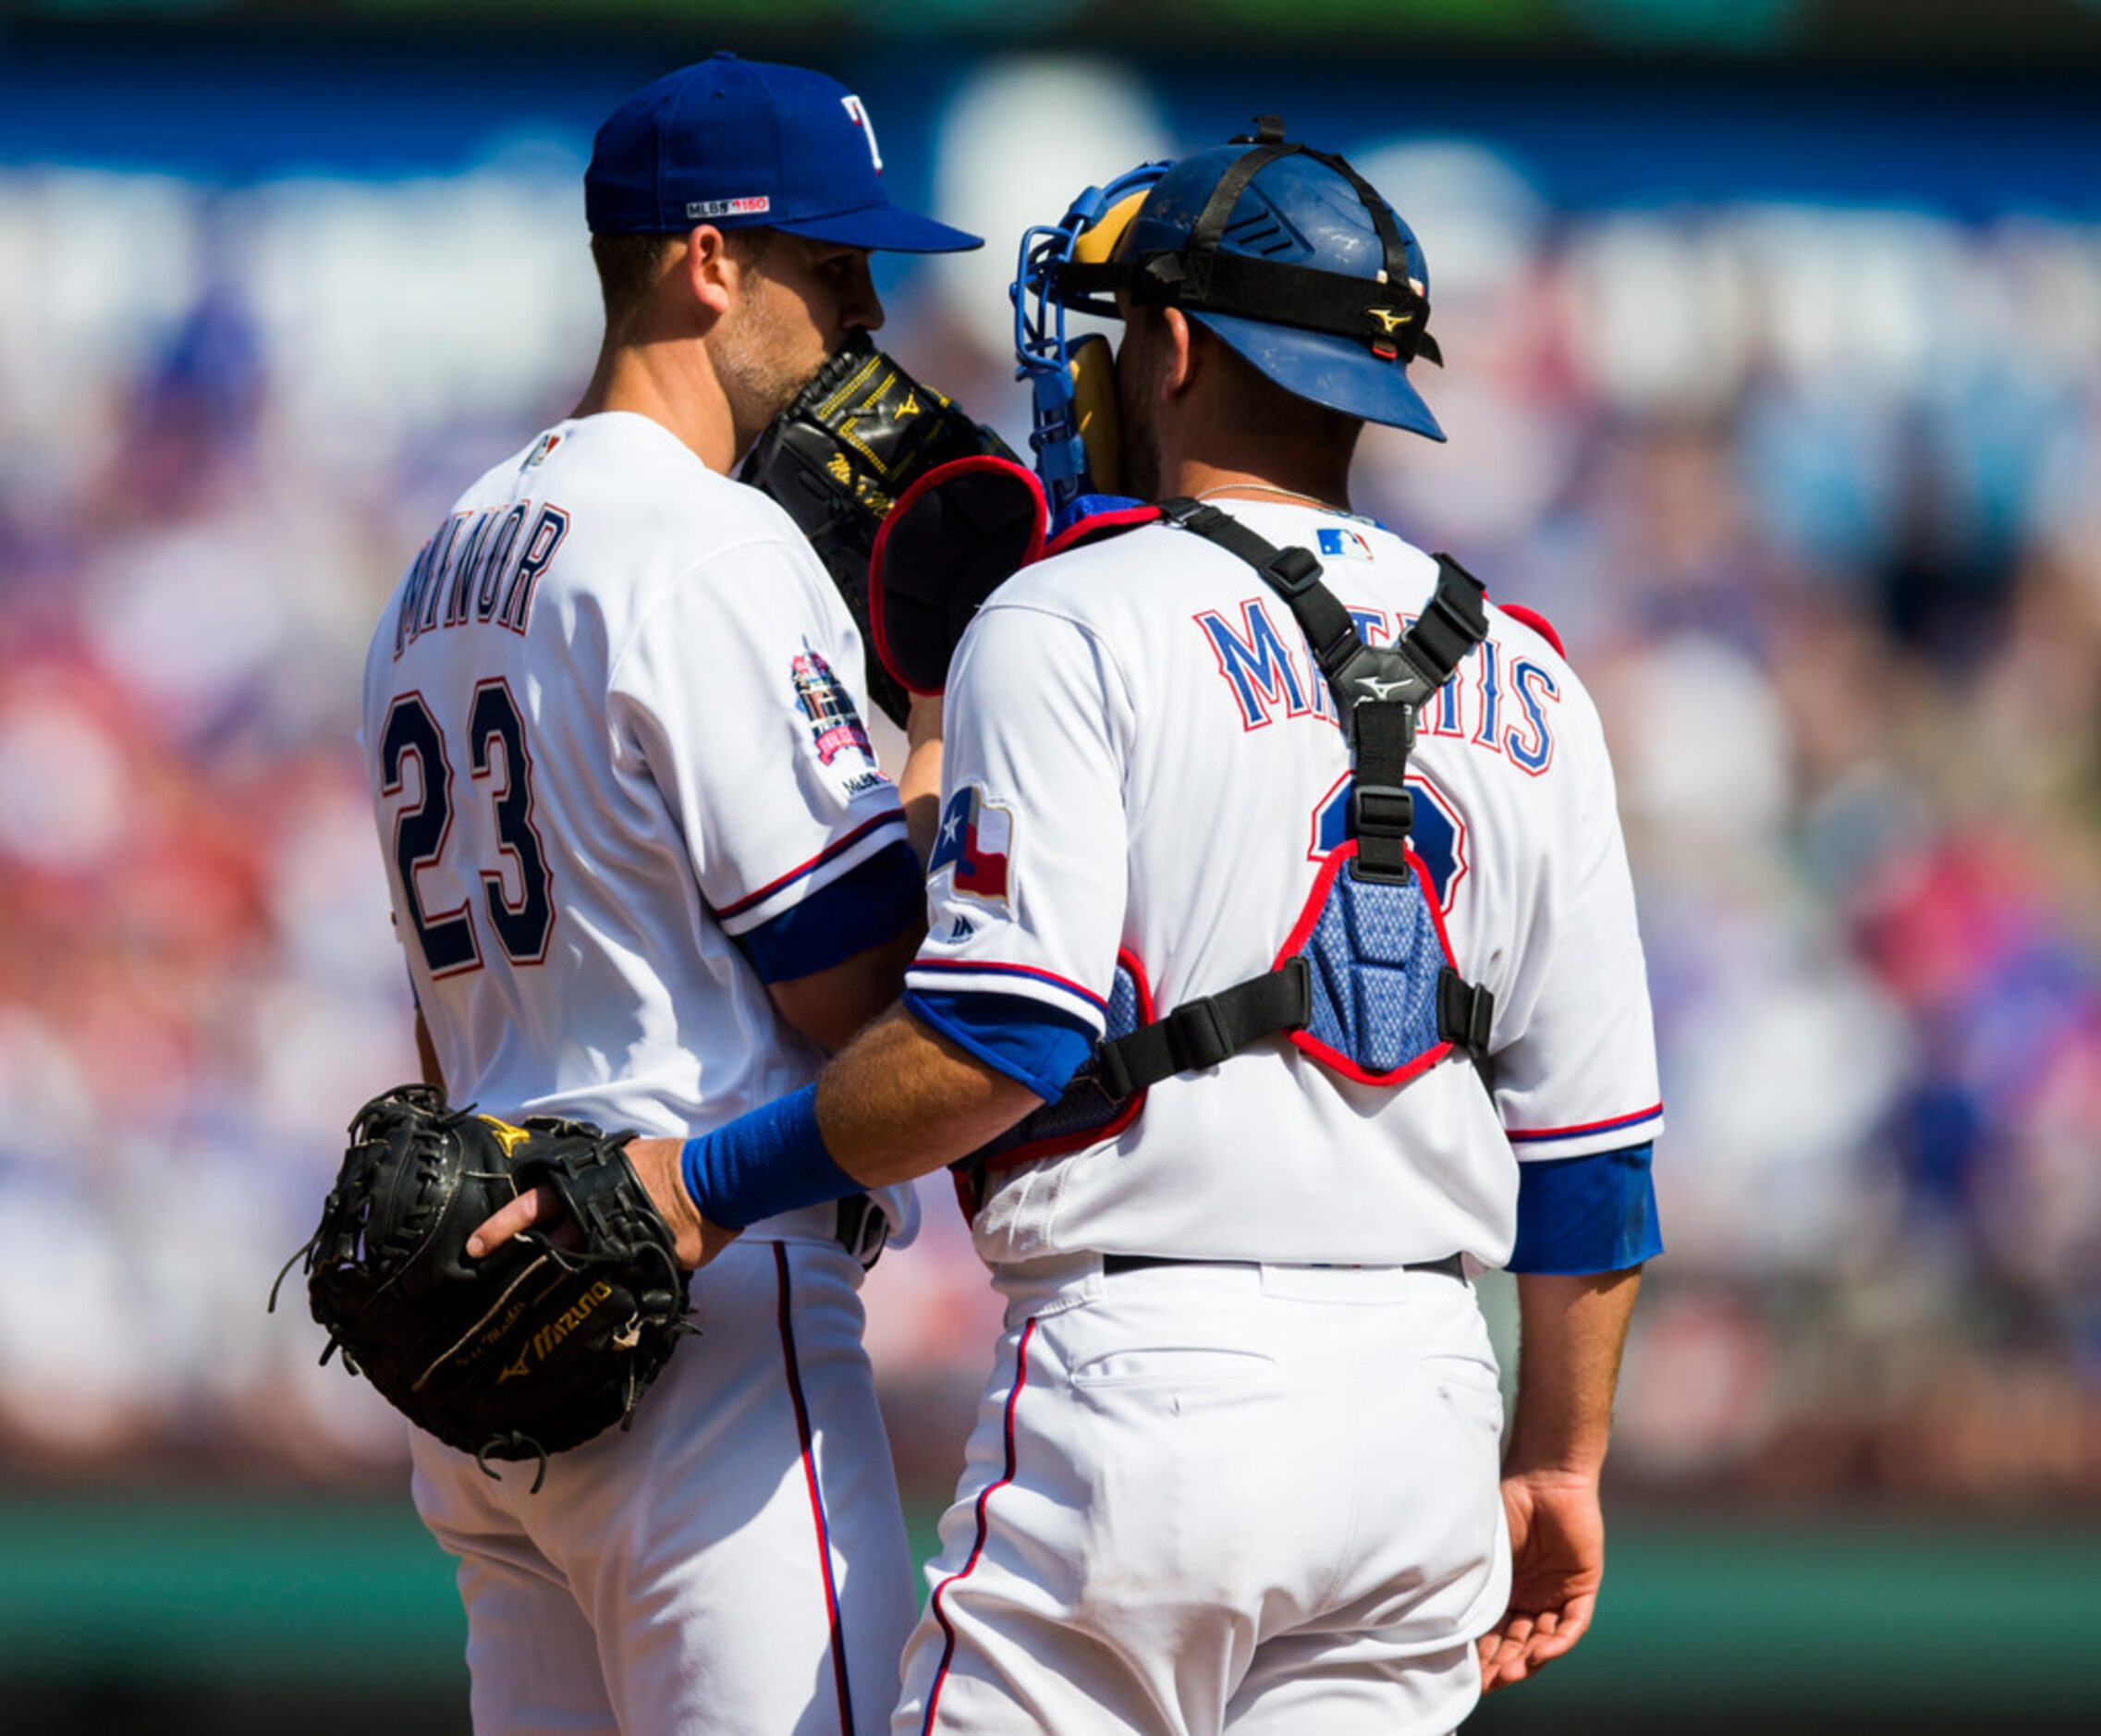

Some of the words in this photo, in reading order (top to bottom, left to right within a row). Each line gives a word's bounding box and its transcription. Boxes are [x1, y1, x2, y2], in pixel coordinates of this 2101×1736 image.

[689, 203, 719, 216] MLB
[392, 499, 571, 663] MINOR
[1192, 596, 1560, 777] MIS
[378, 676, 556, 981] 23
